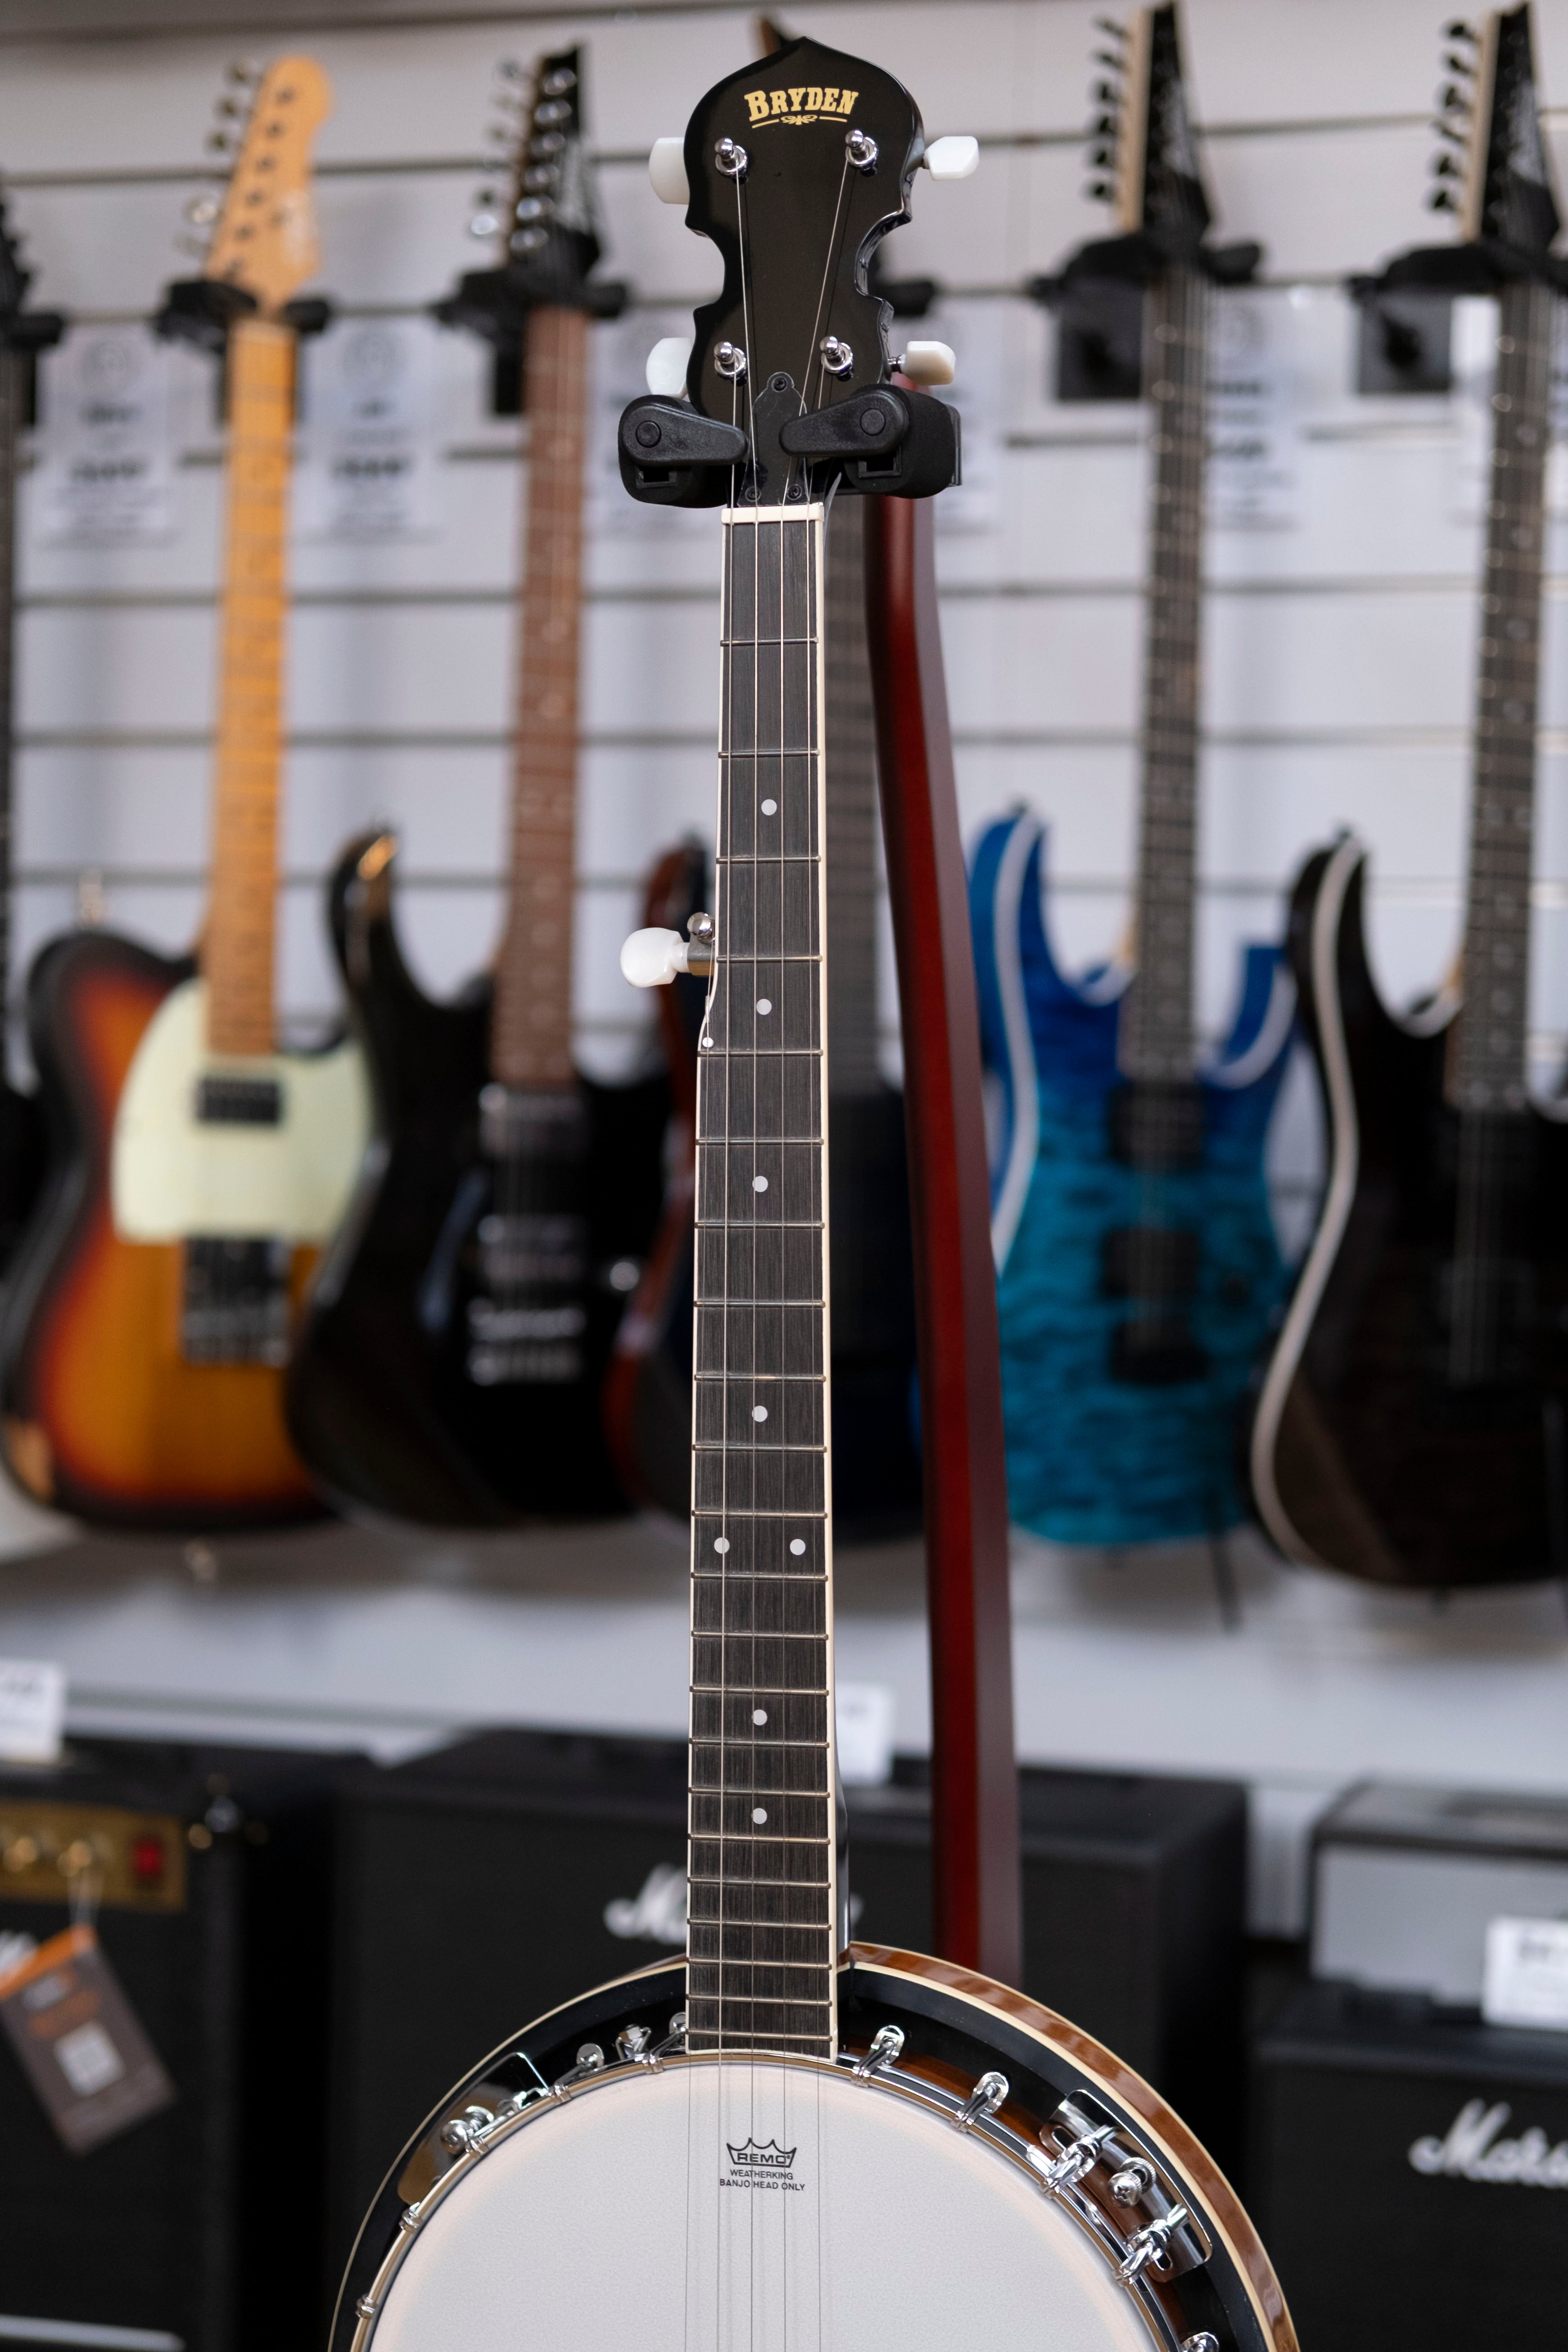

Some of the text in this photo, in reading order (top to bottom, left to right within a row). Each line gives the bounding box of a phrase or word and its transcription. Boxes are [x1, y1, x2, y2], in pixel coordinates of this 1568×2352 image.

[744, 87, 859, 122] BRYDEN
[737, 2153, 786, 2164] REMO
[730, 2169, 793, 2180] WEATHERKING
[720, 2178, 750, 2188] BANJO
[753, 2180, 778, 2189] HEAD
